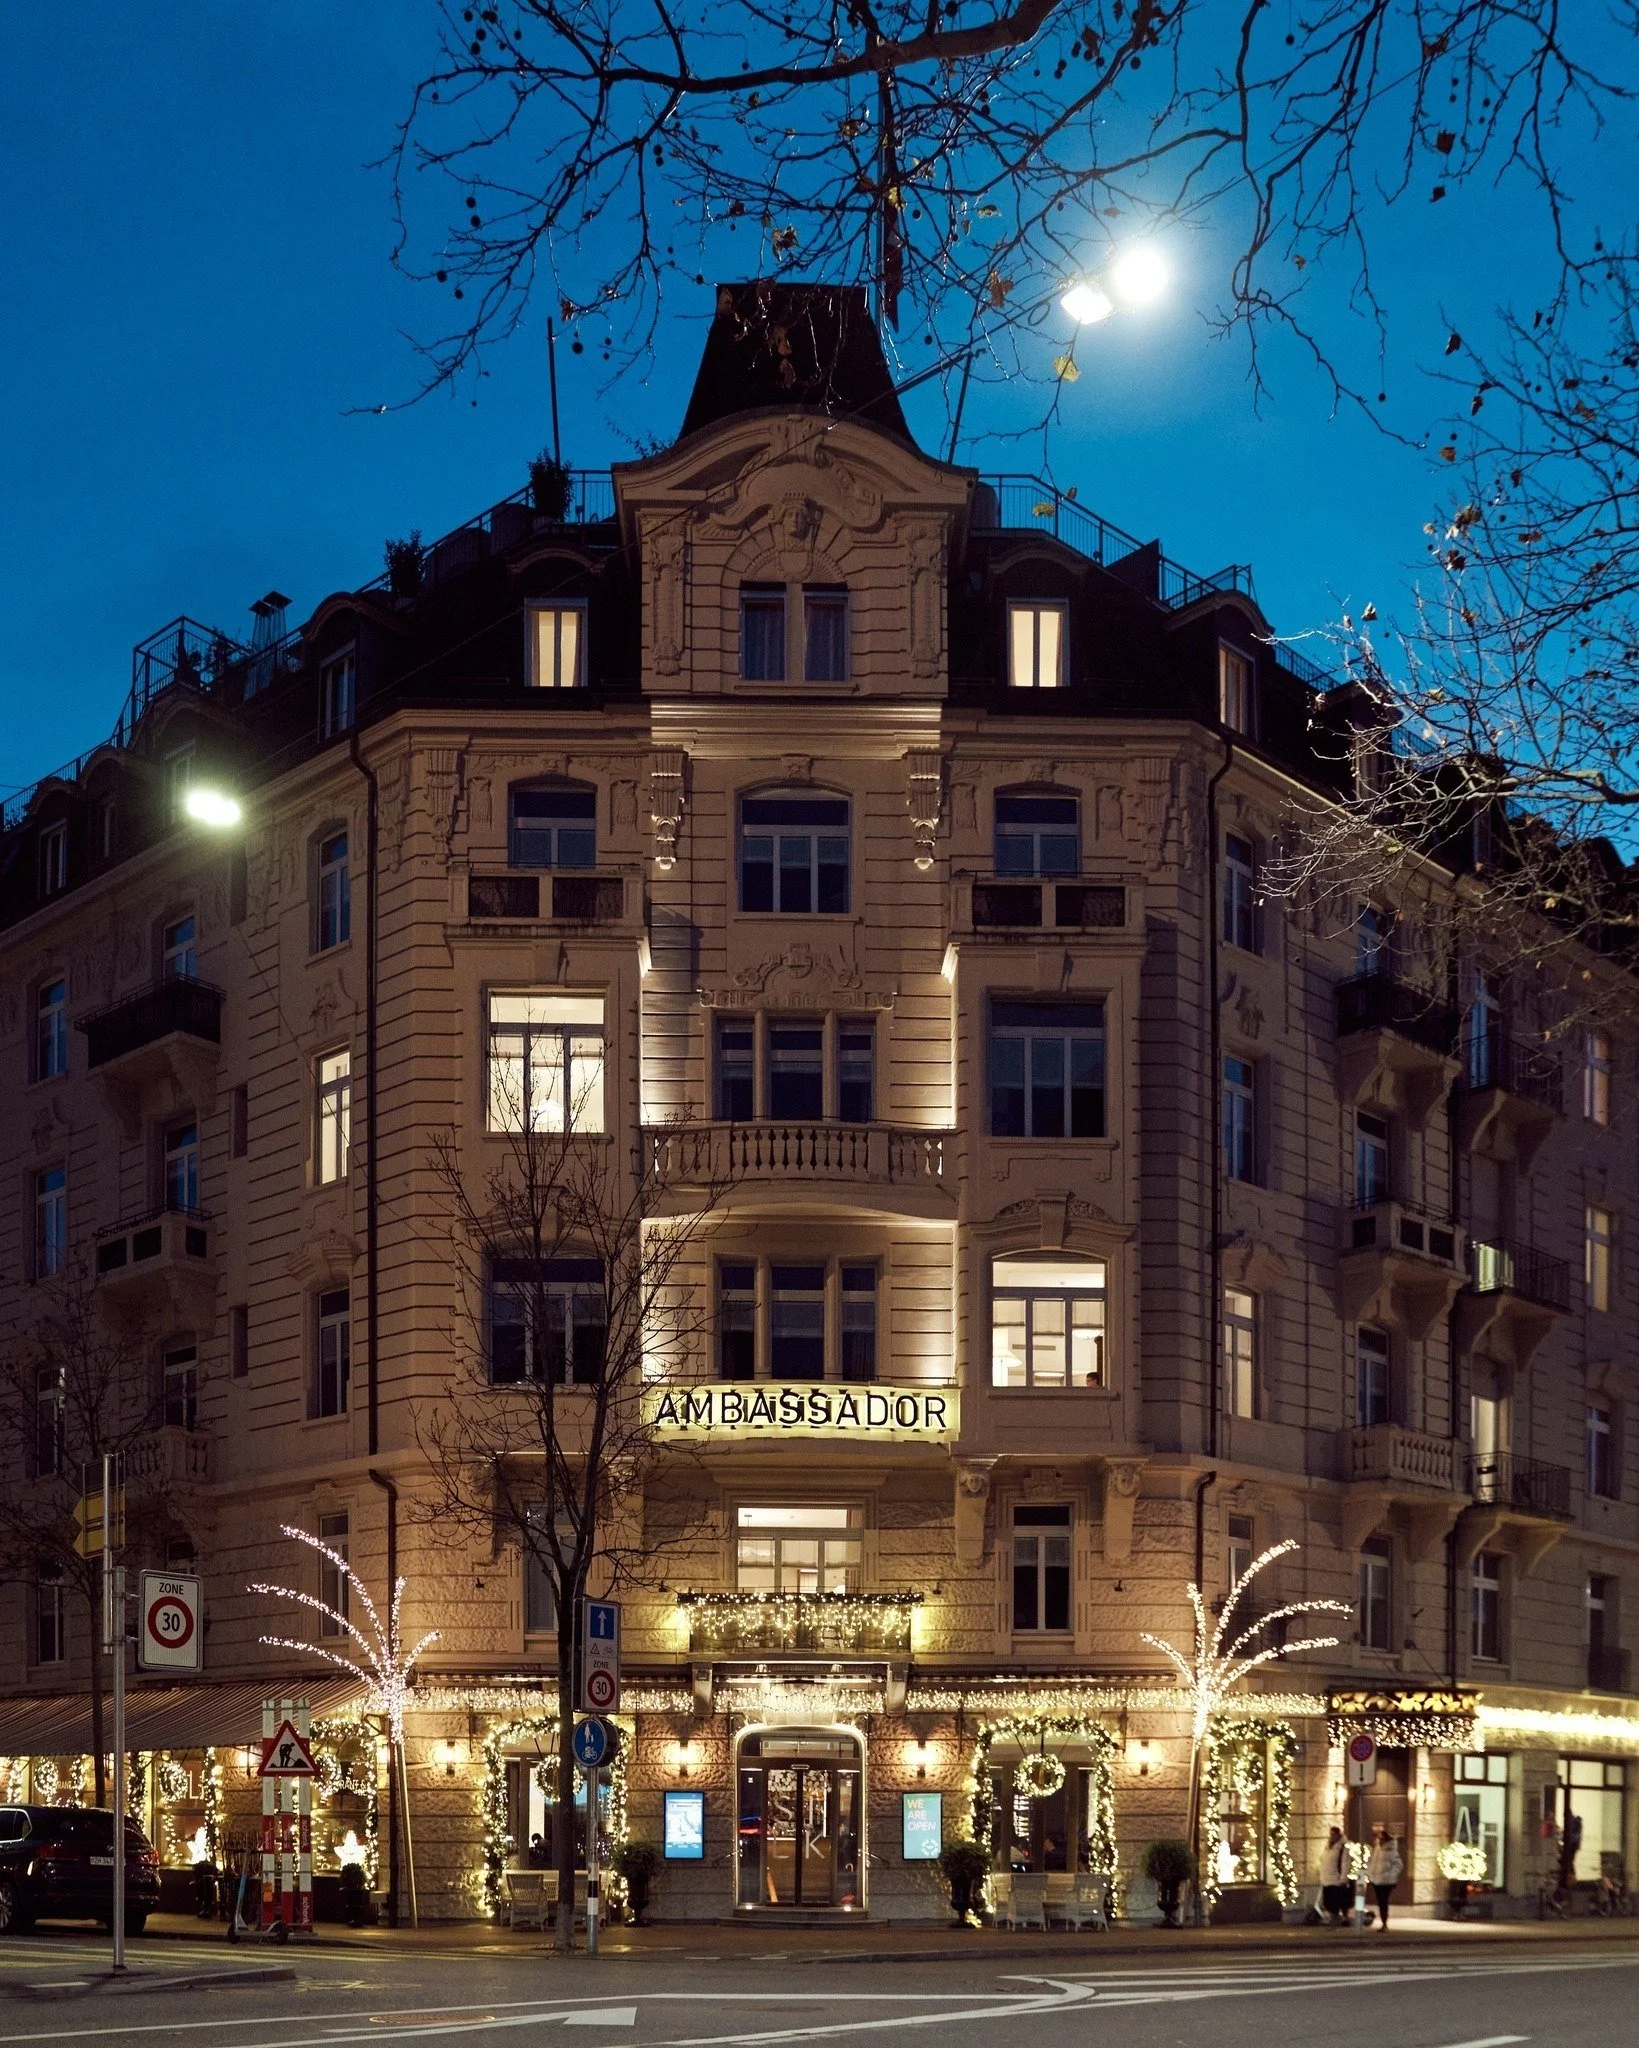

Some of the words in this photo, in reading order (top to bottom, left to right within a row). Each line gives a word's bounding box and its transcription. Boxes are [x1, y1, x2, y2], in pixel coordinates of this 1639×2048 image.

[656, 1391, 947, 1428] AMBASSADOR
[159, 1582, 184, 1595] ZONE
[162, 1612, 180, 1632] 30
[593, 1661, 609, 1669] ZONE
[595, 1681, 607, 1695] 30
[907, 1798, 924, 1808] WE
[907, 1811, 927, 1820] ARE
[908, 1822, 936, 1831] OPEN
